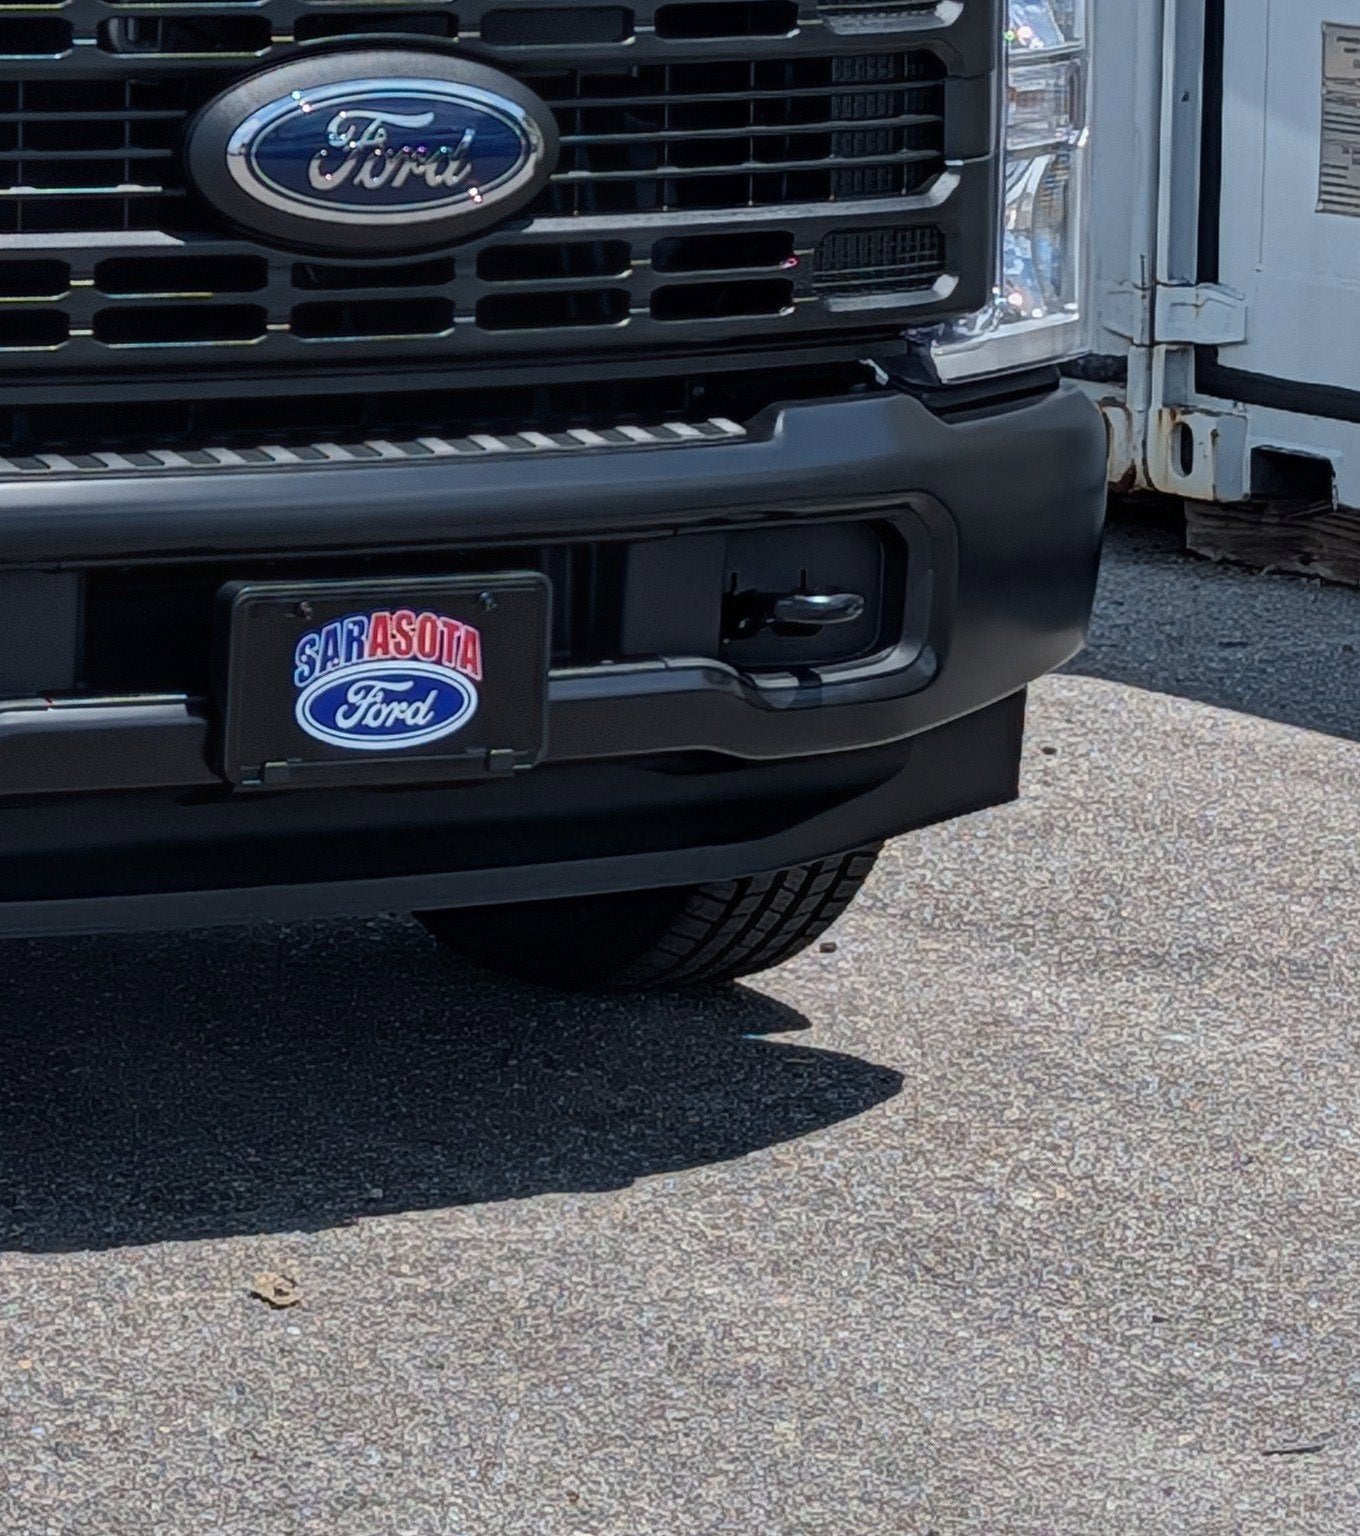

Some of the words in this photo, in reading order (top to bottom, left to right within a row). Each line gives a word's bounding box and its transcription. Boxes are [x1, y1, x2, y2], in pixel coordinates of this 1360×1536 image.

[308, 109, 478, 190] Ford
[293, 610, 483, 689] SARASOTA
[335, 679, 434, 729] Ford
